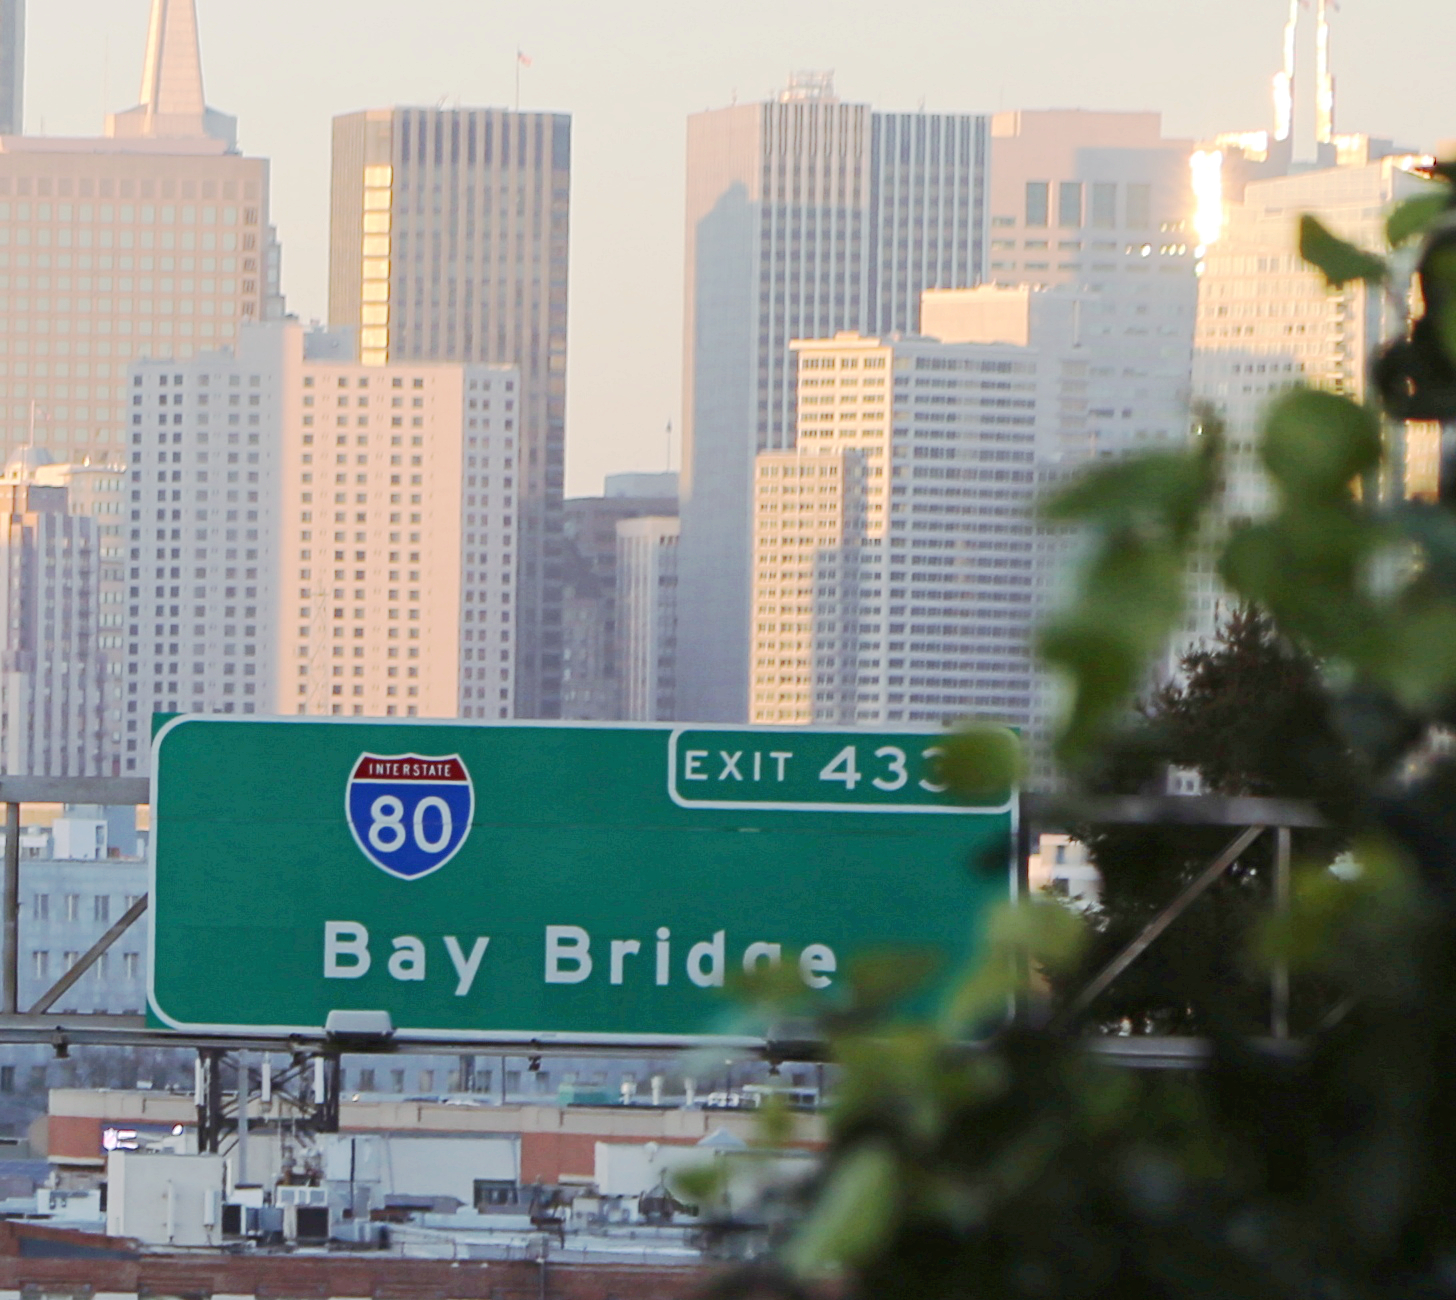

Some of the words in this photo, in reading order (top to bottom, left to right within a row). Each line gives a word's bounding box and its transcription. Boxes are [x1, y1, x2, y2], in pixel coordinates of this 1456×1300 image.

[369, 763, 452, 777] INTERSTATE
[684, 750, 793, 782] EXIT
[818, 745, 951, 793] 433
[367, 794, 453, 854] 80
[323, 920, 491, 997] Bay
